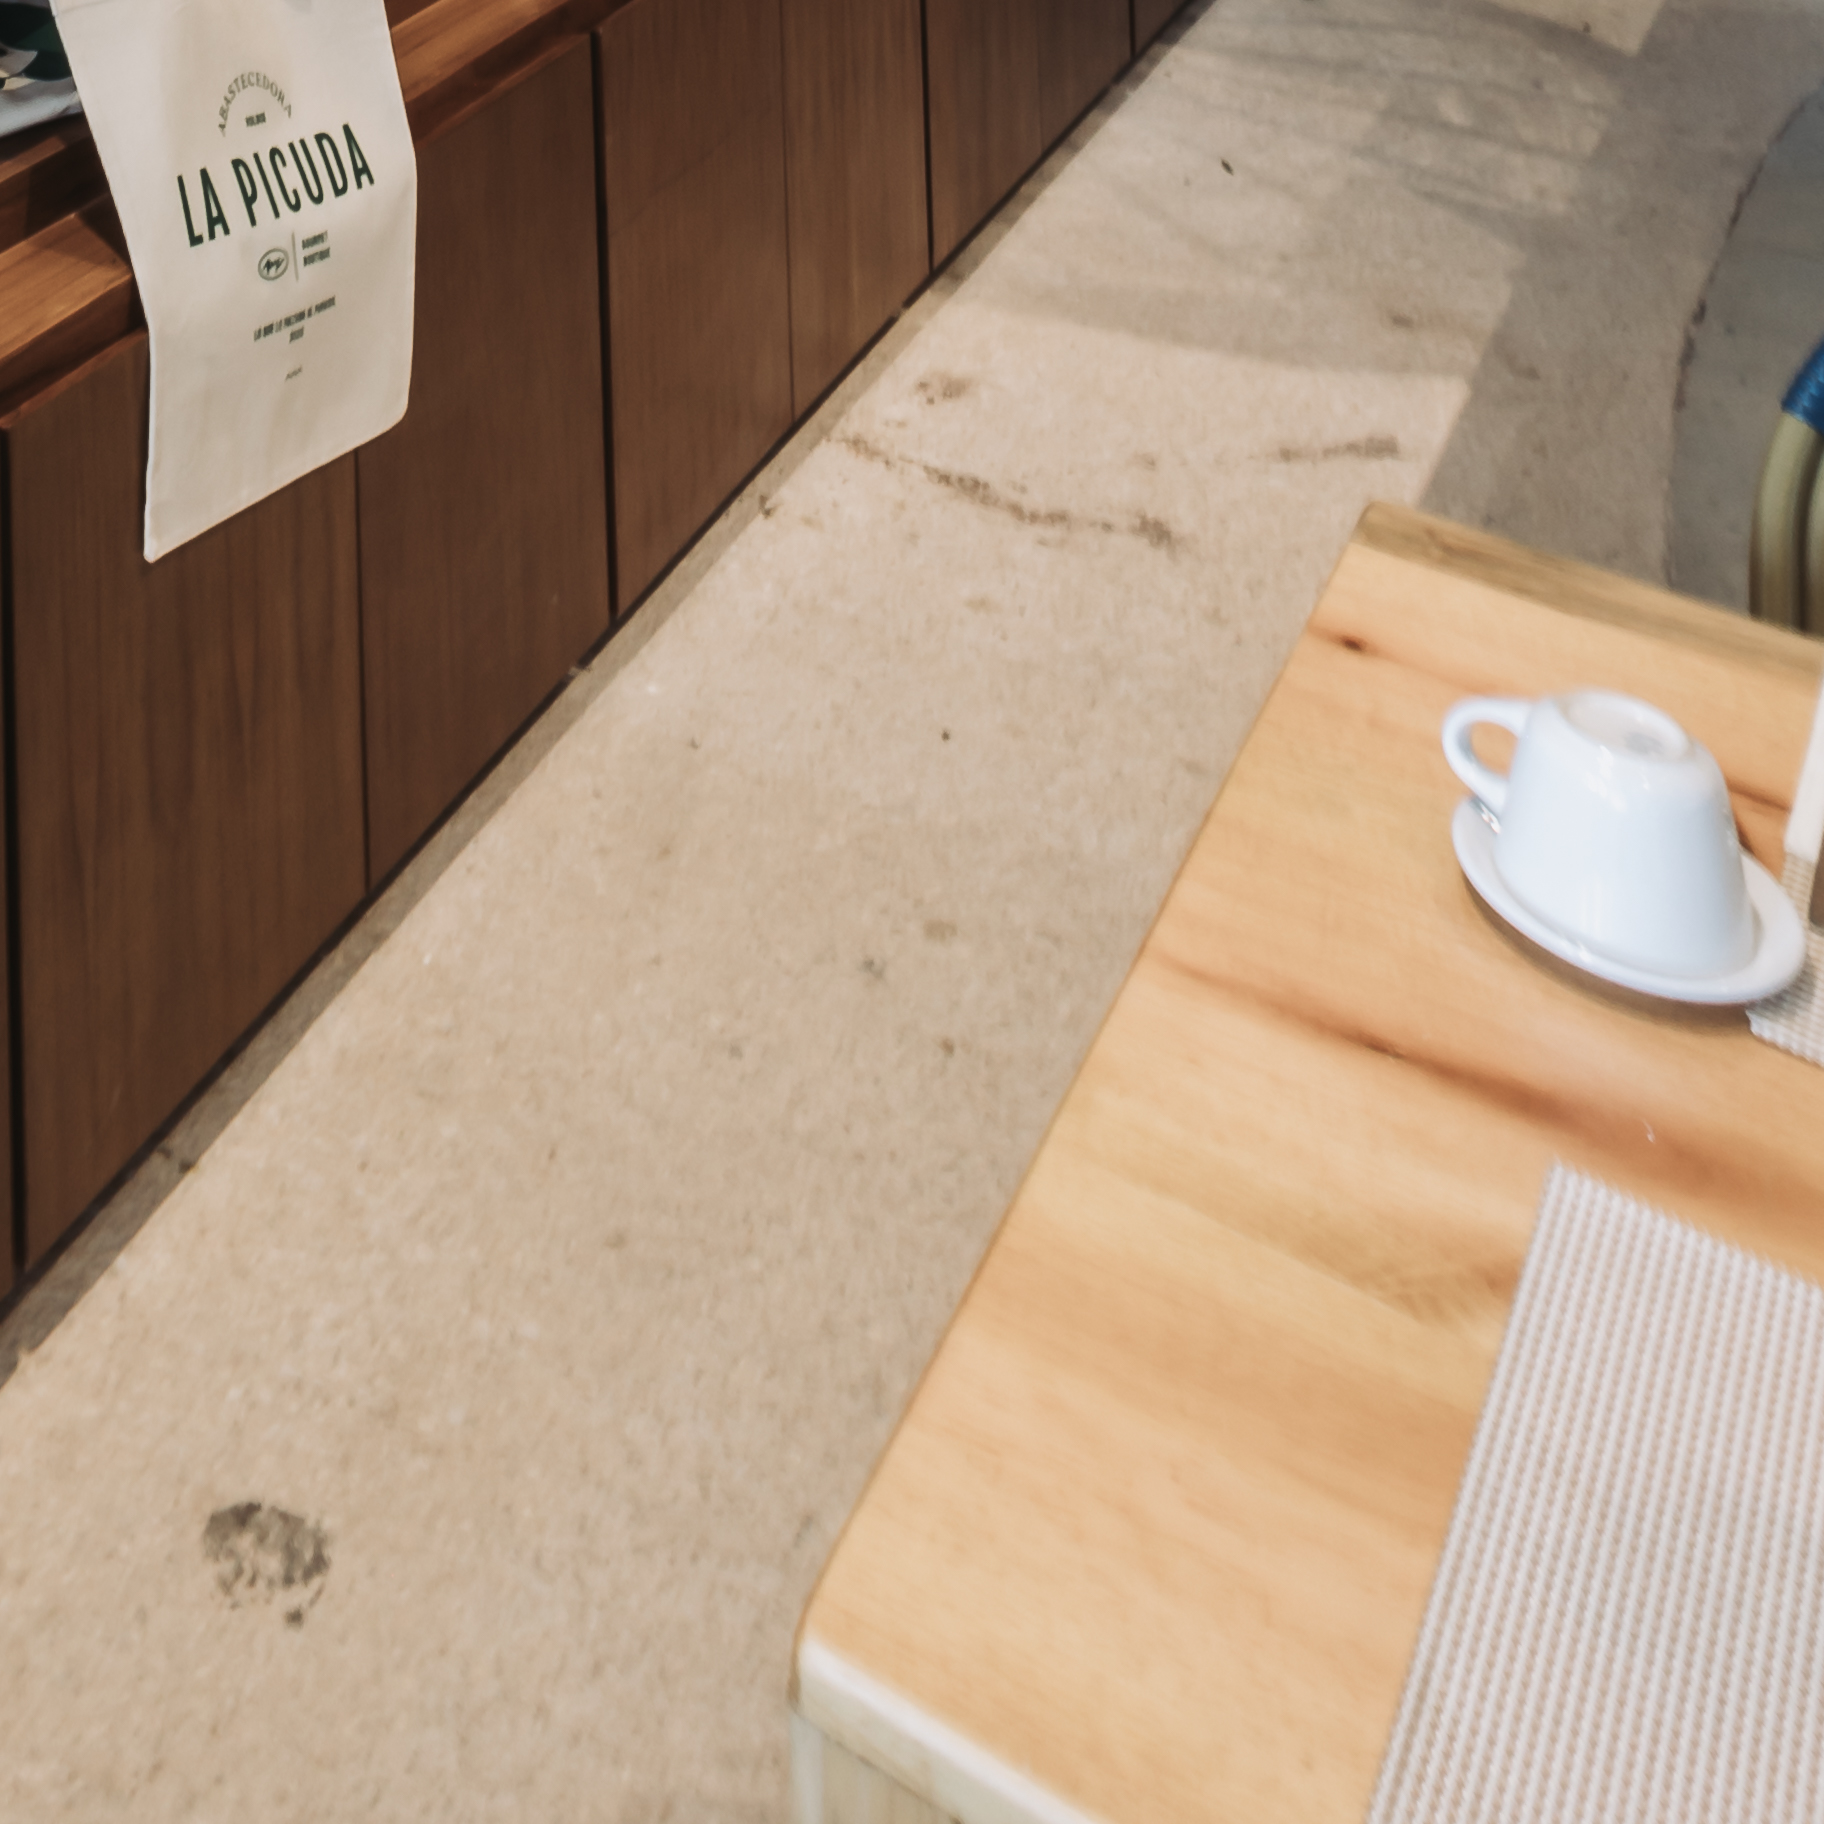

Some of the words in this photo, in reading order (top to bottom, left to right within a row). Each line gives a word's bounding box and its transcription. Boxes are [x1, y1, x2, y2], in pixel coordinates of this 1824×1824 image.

[218, 71, 292, 138] ABASTECEDORA
[176, 166, 231, 248] LA
[231, 123, 375, 228] PICUDA
